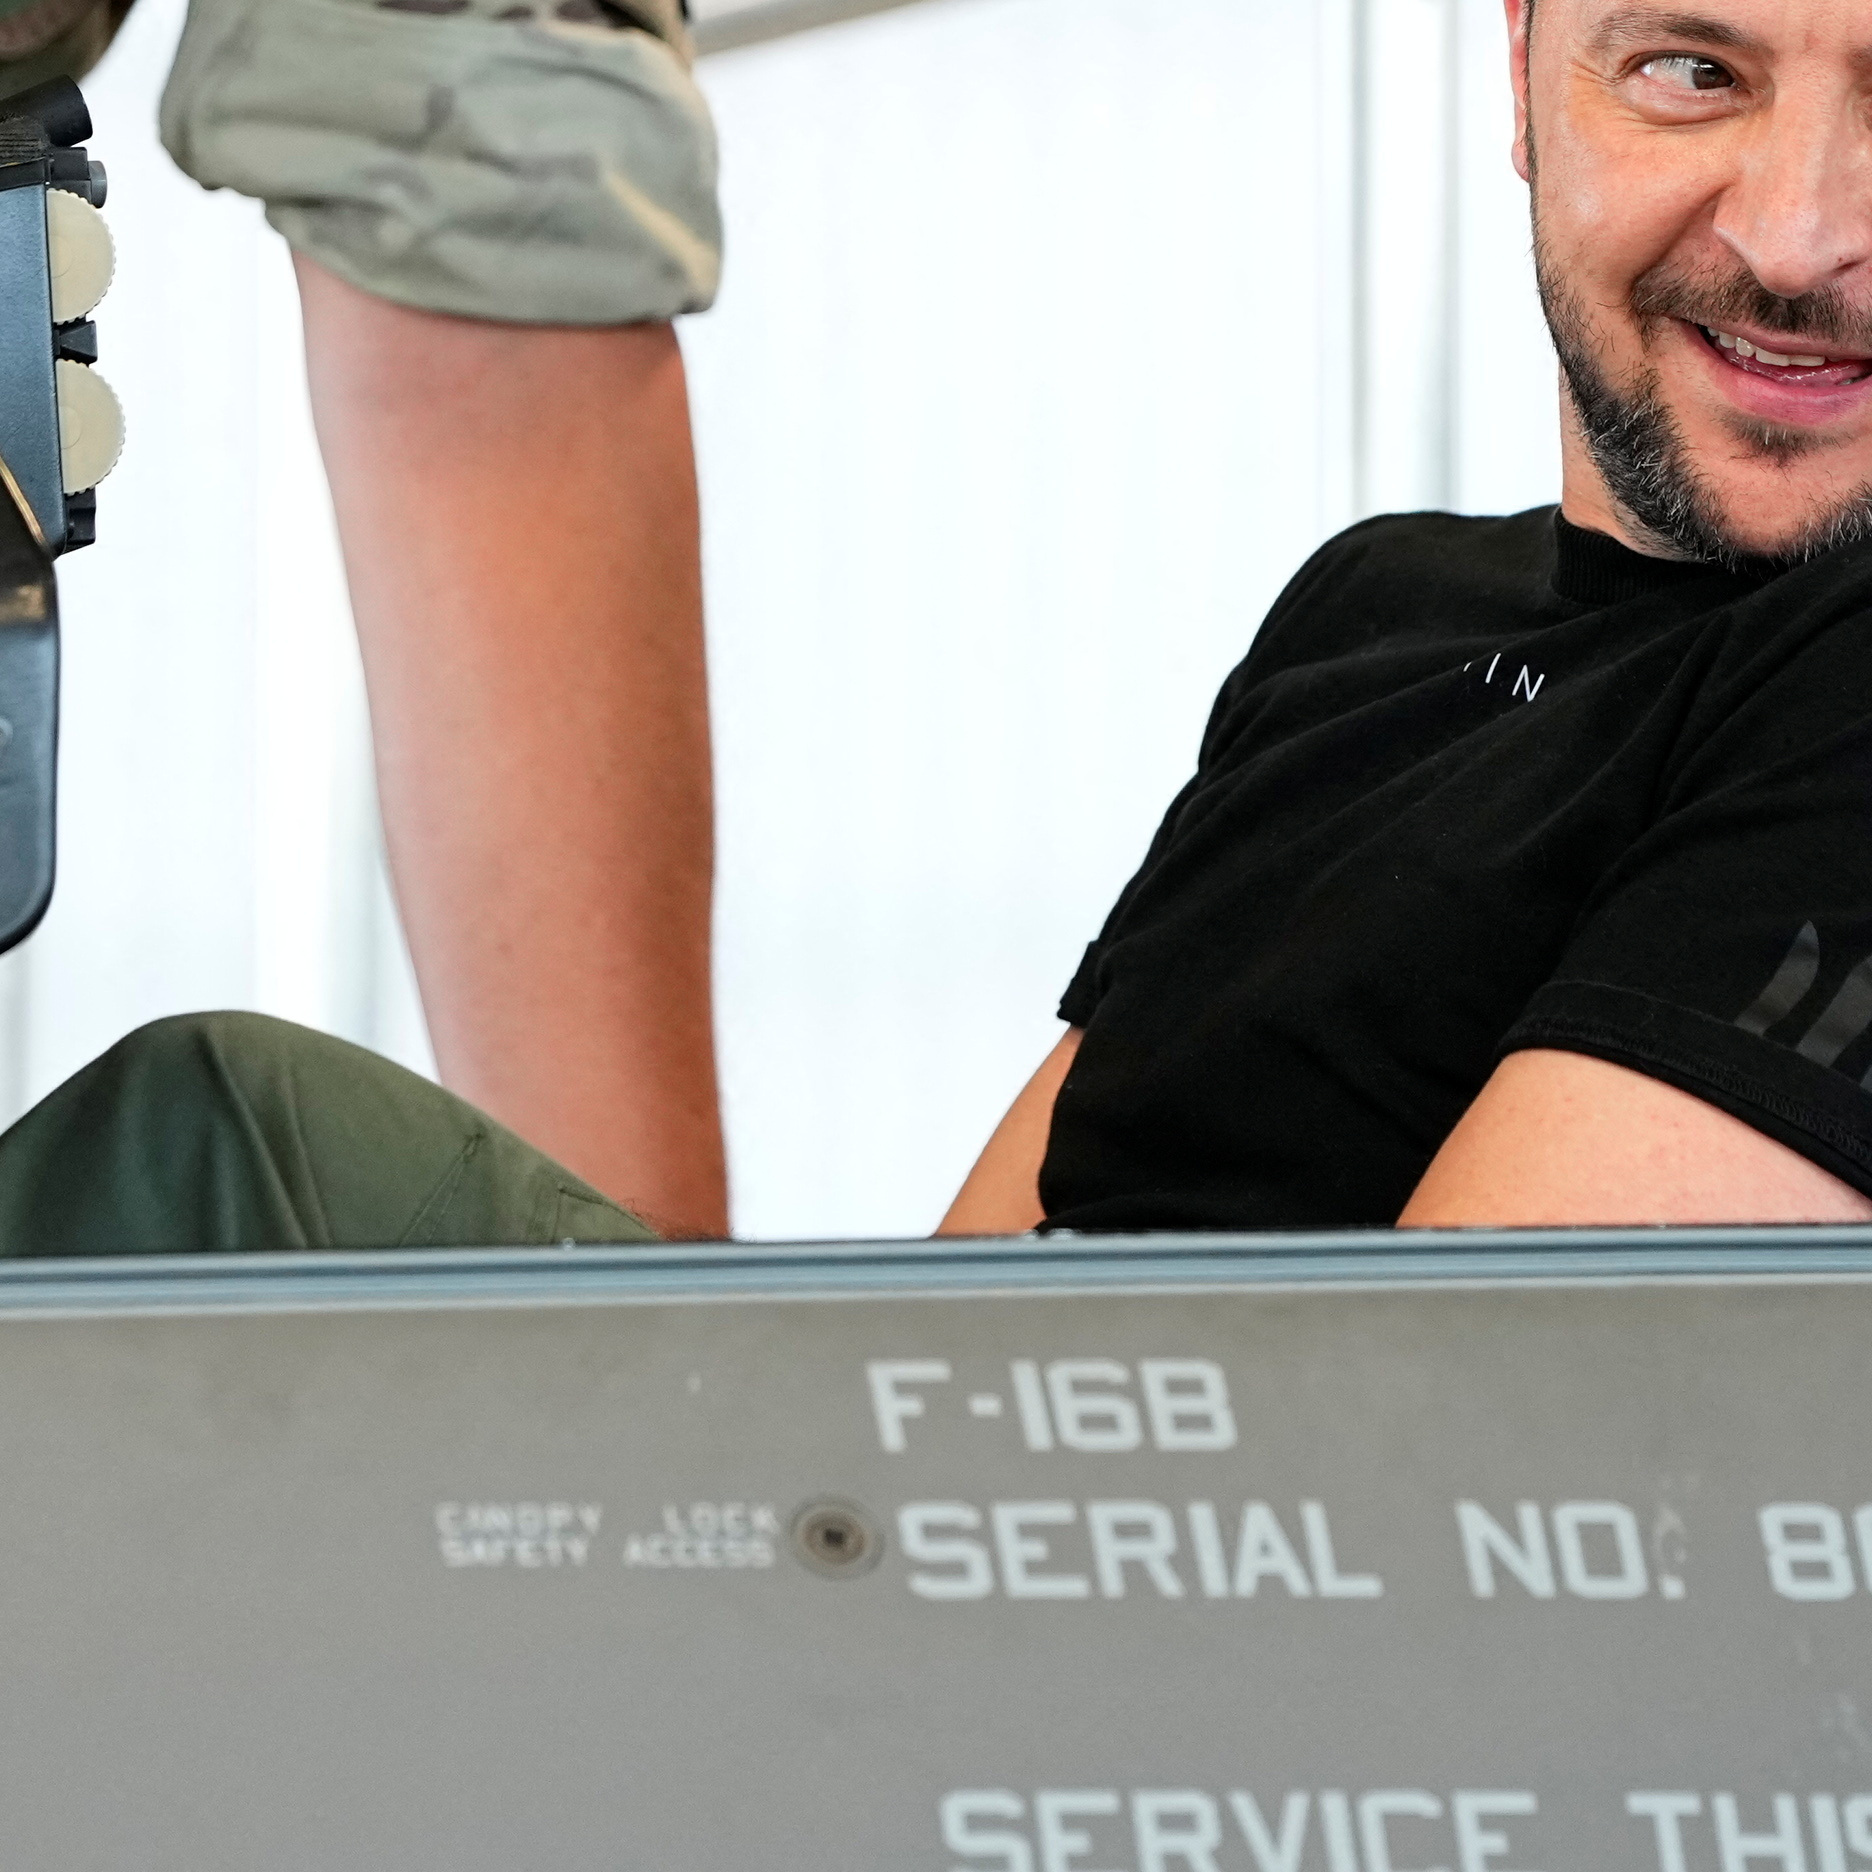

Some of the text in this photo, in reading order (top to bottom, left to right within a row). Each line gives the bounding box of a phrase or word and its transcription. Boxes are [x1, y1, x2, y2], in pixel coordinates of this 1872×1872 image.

[1463, 652, 1545, 702] IN
[866, 1358, 1237, 1452] F-16B
[897, 1499, 1385, 1600] SERIAL
[939, 1788, 1538, 1872] SERVICE
